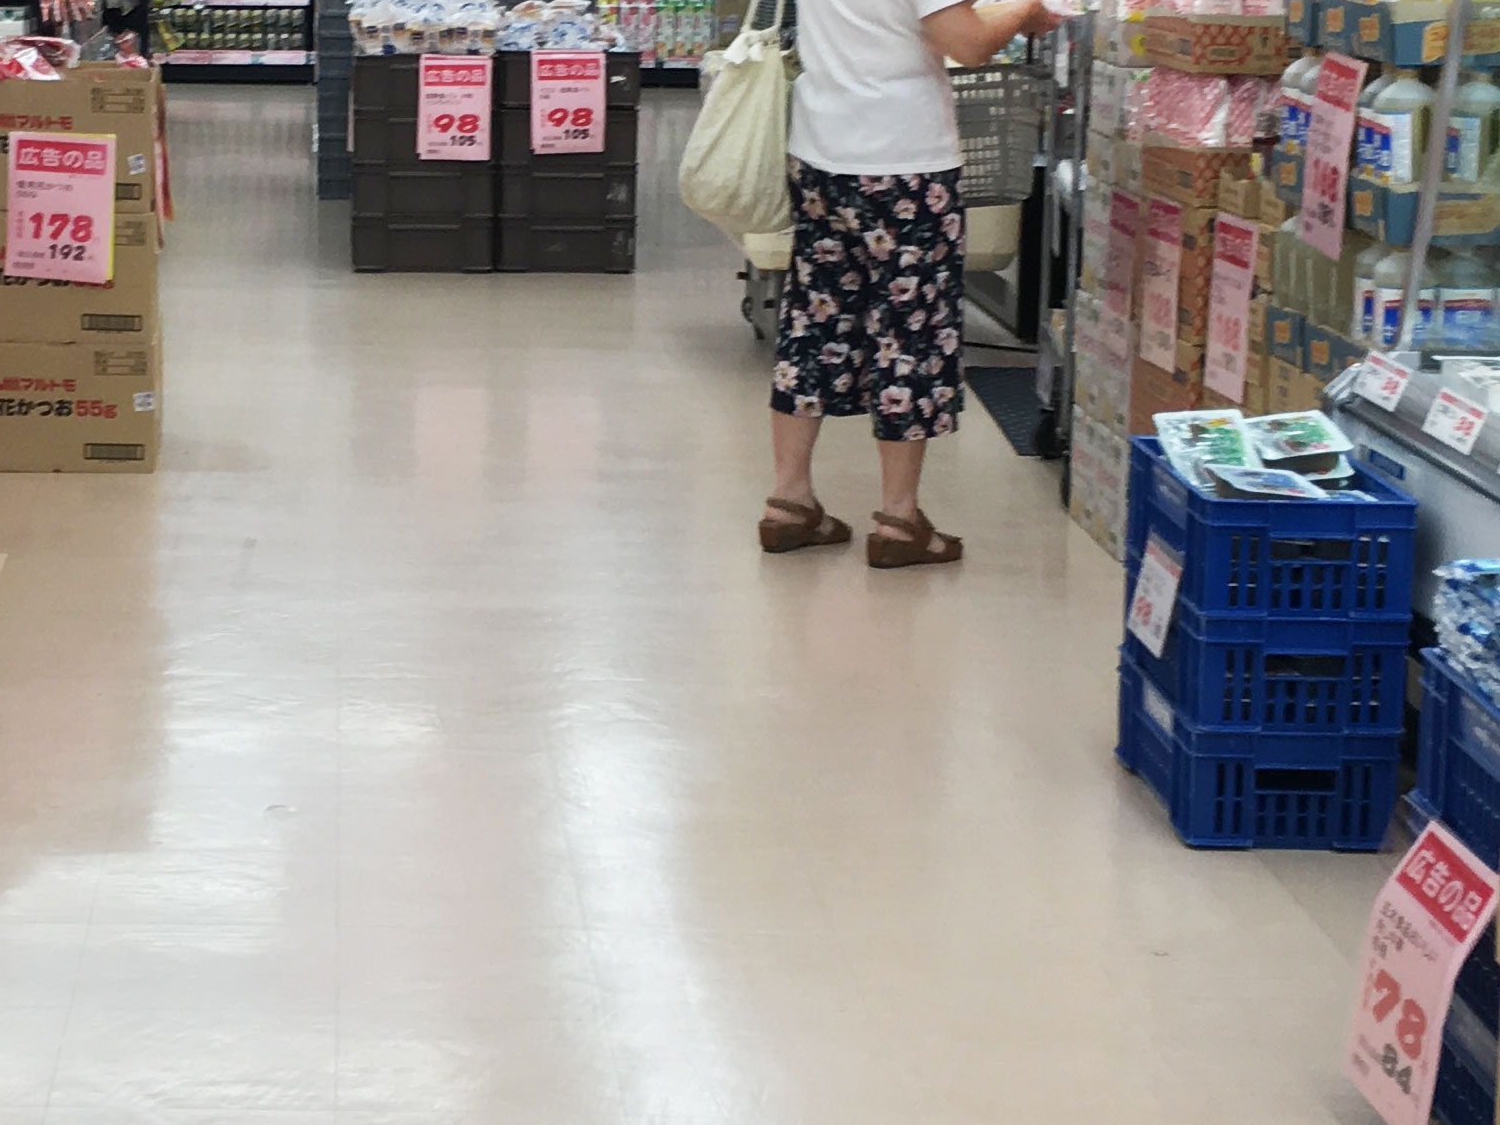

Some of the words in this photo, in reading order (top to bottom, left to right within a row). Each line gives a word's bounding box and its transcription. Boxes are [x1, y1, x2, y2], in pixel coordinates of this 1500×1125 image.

[433, 114, 481, 134] 98
[547, 108, 594, 127] 98
[450, 135, 477, 146] 105
[563, 128, 590, 140] 105
[19, 147, 106, 170] 広告の品
[29, 212, 94, 244] 178
[49, 244, 86, 262] 192
[1407, 847, 1485, 931] 広告の品
[1372, 969, 1428, 1060] 78
